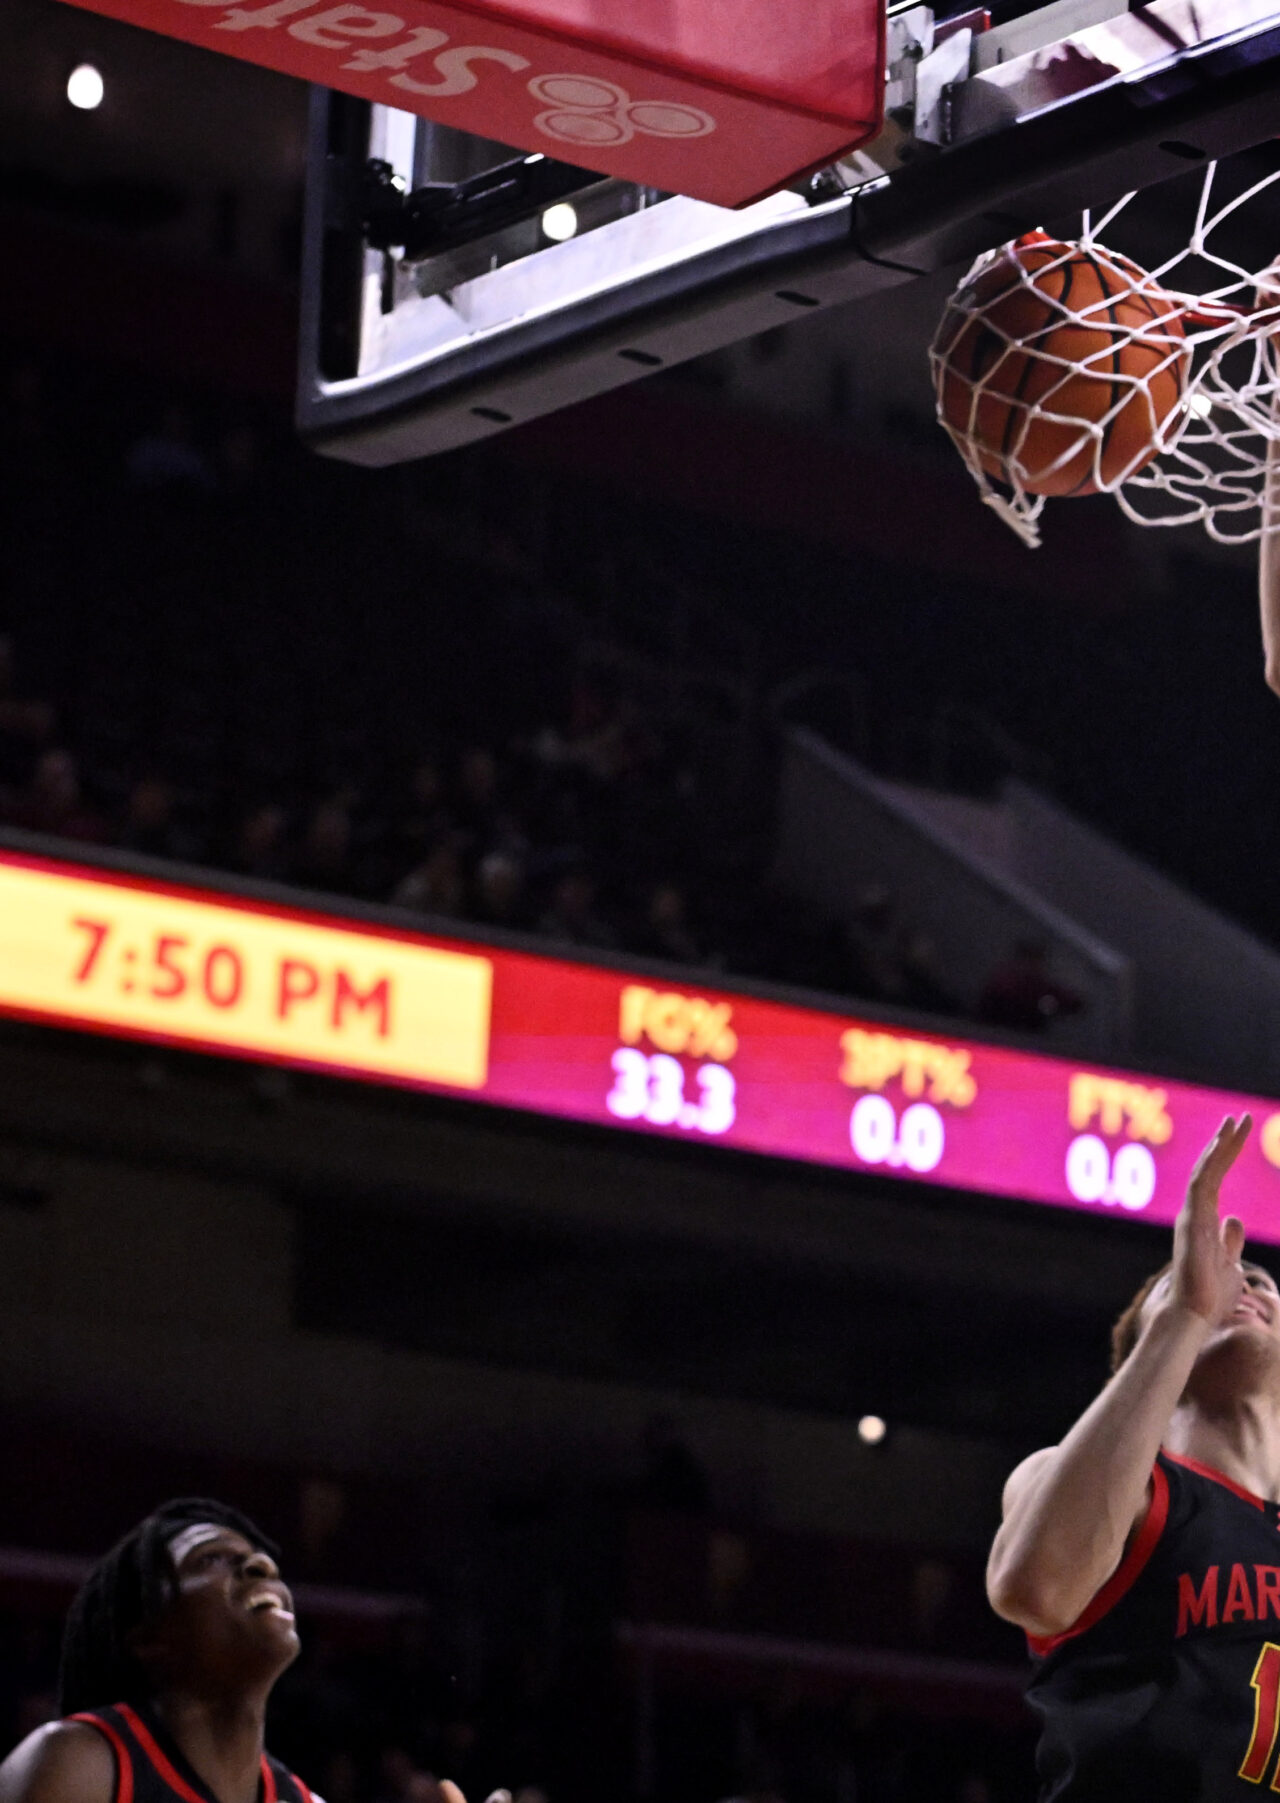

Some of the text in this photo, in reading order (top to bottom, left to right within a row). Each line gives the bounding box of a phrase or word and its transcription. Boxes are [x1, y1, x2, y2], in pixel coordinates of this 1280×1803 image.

[172, 0, 531, 97] Stat
[69, 917, 392, 1040] 7:50 PM
[606, 1047, 737, 1135] 33.3
[849, 1094, 945, 1172] 0.0
[1065, 1133, 1157, 1211] 0.0
